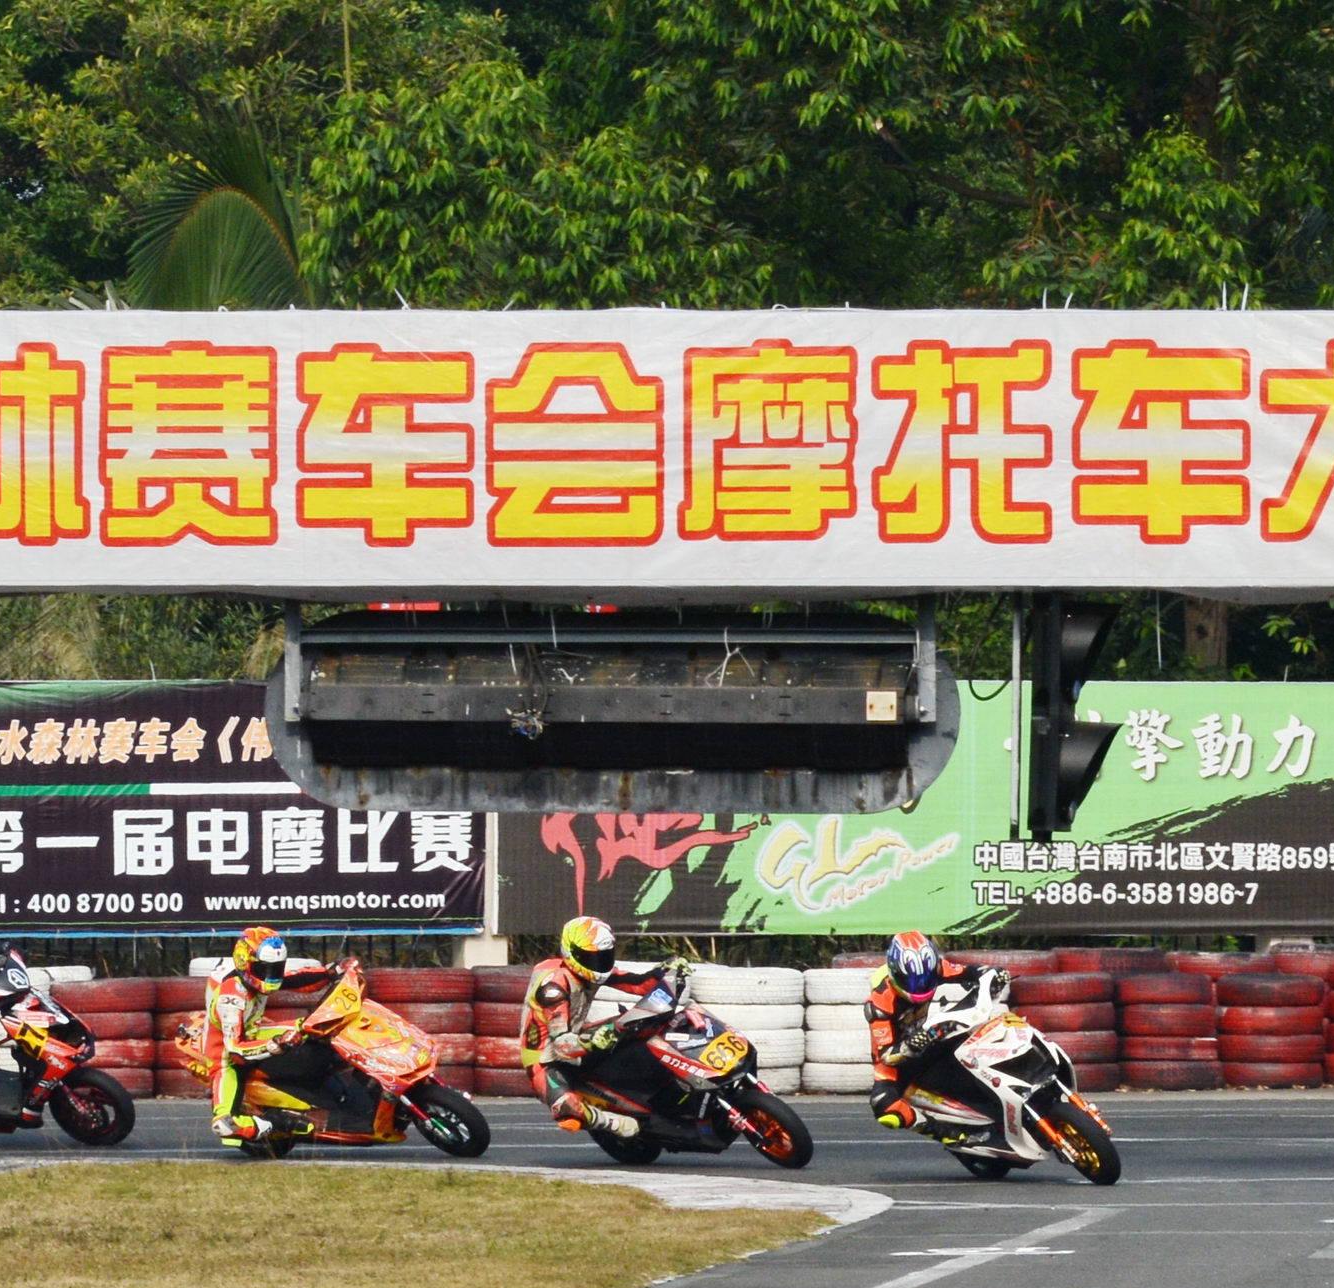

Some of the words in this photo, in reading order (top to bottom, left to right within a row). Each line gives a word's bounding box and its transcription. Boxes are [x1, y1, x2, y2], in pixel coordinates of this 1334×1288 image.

[1075, 712, 1315, 780] 擎動力
[27, 893, 71, 914] 400
[76, 893, 135, 914] 8700
[140, 893, 183, 914] 500
[204, 891, 446, 914] www.cnqsmotor.com
[972, 882, 1024, 905] TEL:
[707, 1035, 745, 1070] 666
